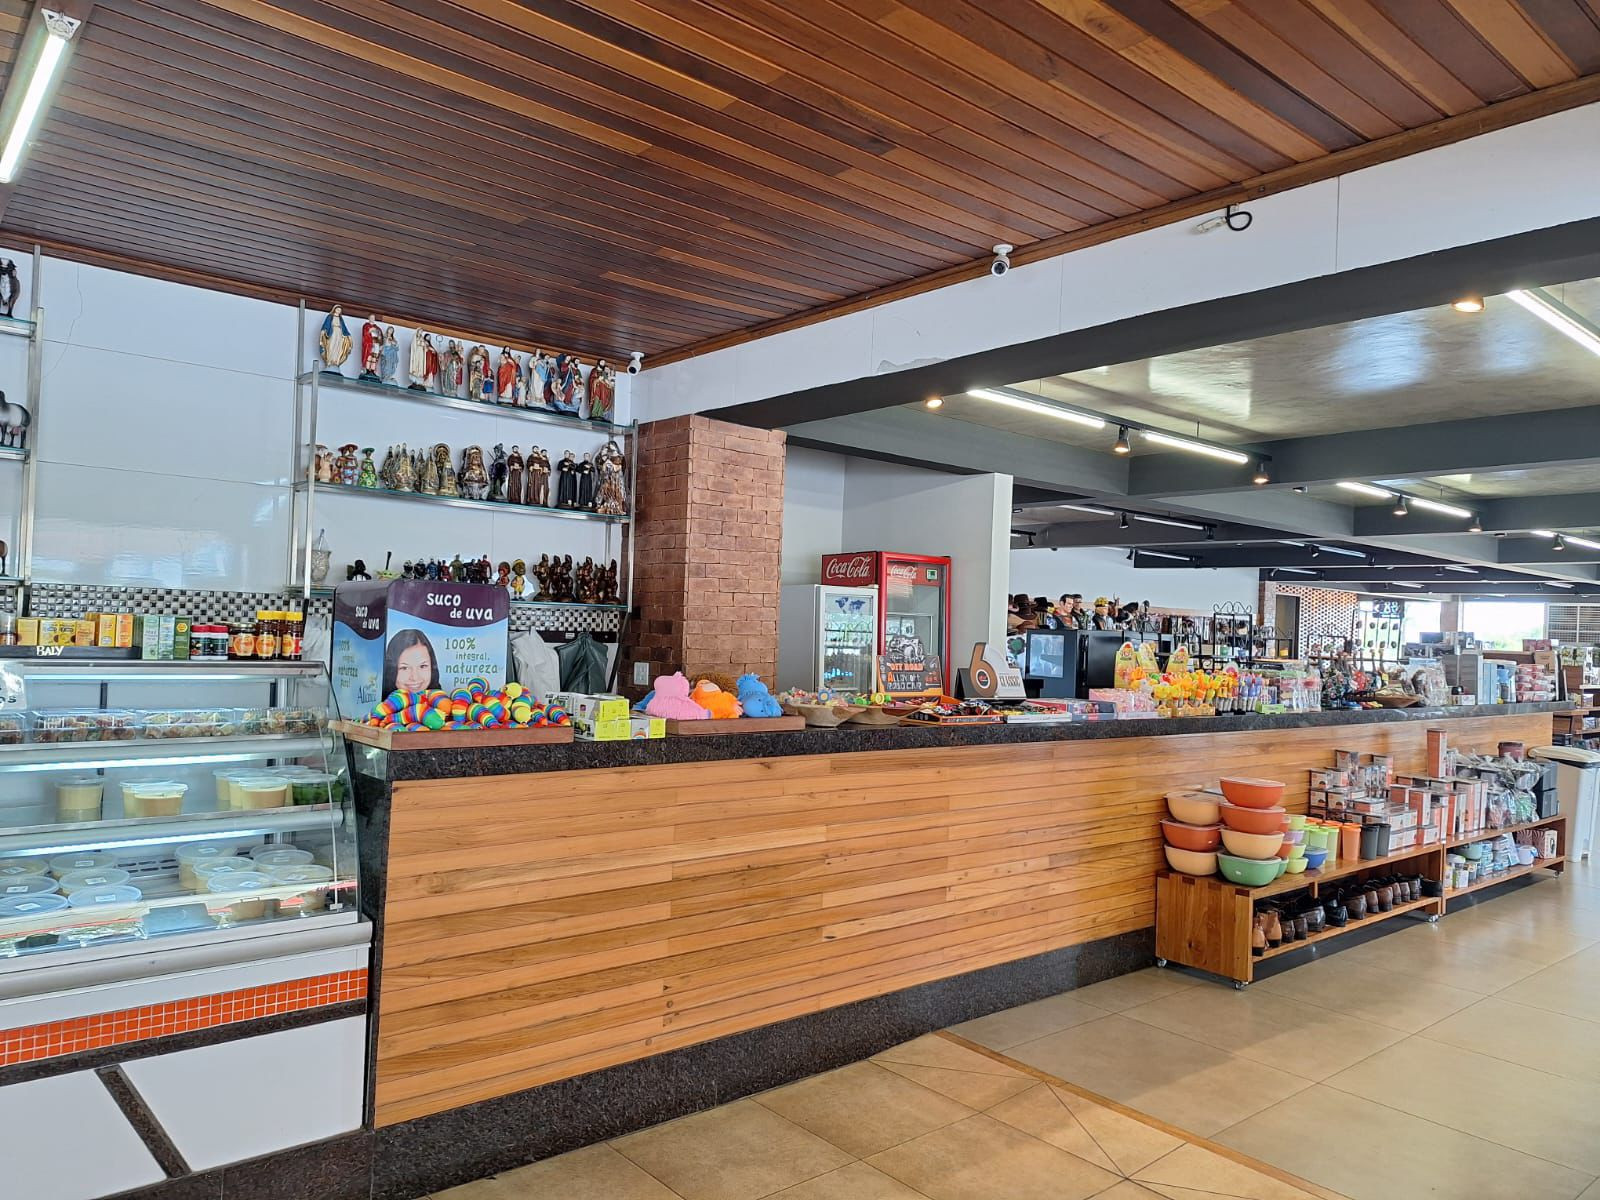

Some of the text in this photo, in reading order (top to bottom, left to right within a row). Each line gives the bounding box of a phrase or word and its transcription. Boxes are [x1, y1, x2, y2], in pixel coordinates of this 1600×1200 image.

[826, 557, 872, 579] Coca-Cola
[426, 593, 461, 606] suco
[449, 608, 493, 620] de uva
[368, 618, 380, 630] uva
[445, 637, 476, 650] 100%
[36, 645, 64, 657] BALY
[445, 662, 498, 674] natureza
